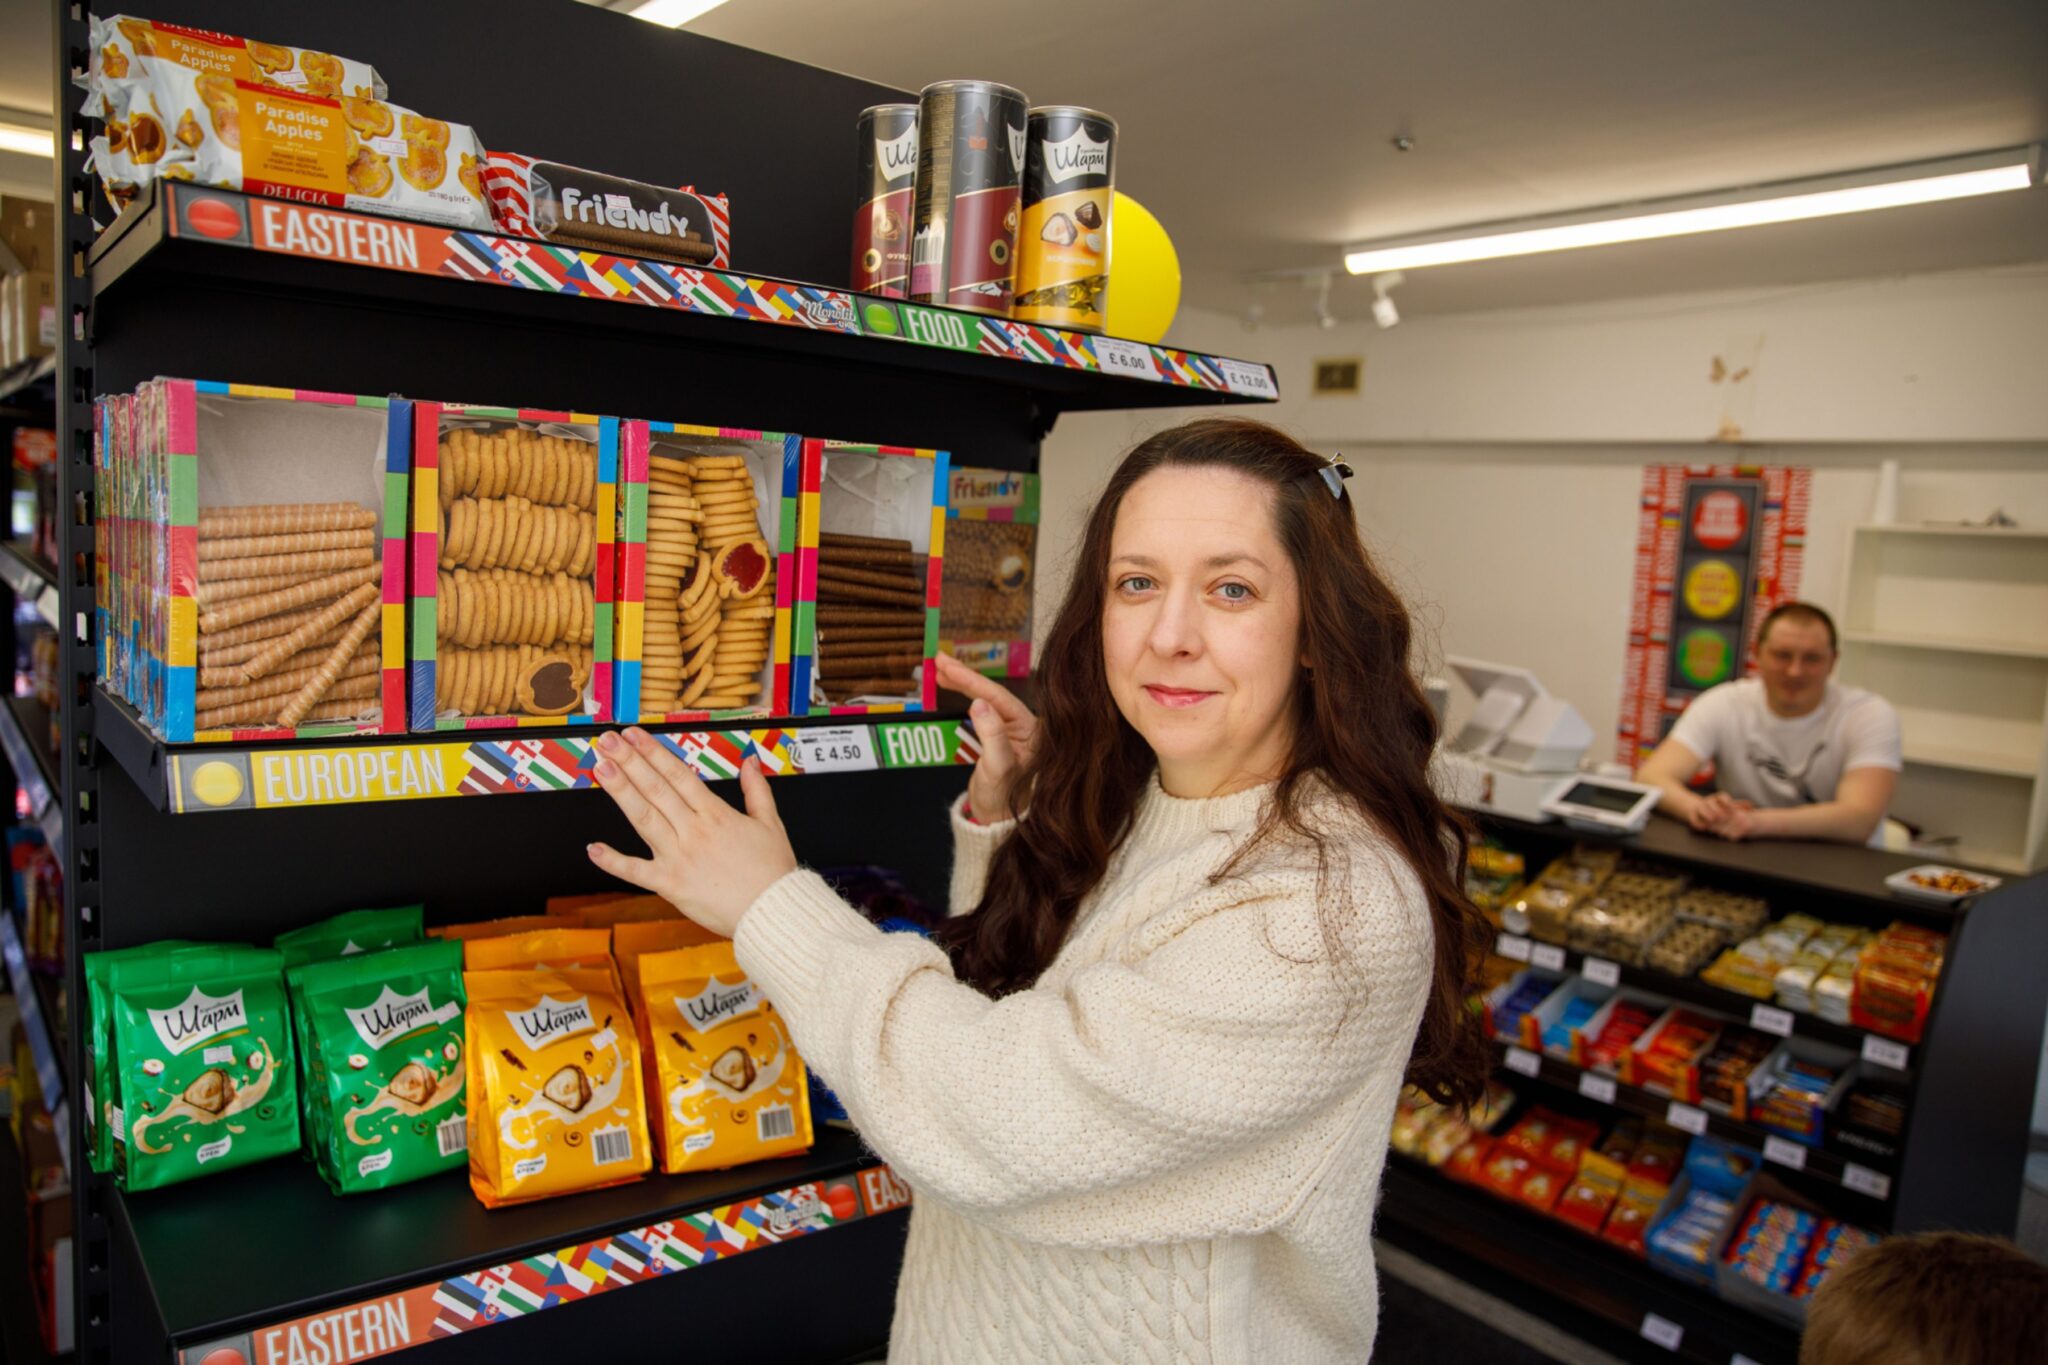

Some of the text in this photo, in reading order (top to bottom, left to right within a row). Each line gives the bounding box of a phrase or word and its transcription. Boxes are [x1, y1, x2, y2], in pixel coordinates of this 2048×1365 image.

[171, 40, 236, 62] Paradise
[181, 53, 231, 72] Apples
[256, 102, 329, 127] Paradise
[265, 119, 323, 141] Apples
[1055, 143, 1105, 171] Шарм
[262, 204, 419, 269] EASTERN
[905, 308, 968, 348] FOOD
[1109, 353, 1146, 370] £ 6.00
[1230, 372, 1268, 390] £ 12.00
[815, 747, 825, 762] £
[829, 744, 861, 761] 4.50
[885, 725, 947, 765] FOOD
[263, 749, 446, 804] EUROPEAN
[164, 1004, 240, 1040] Шарм
[361, 1003, 429, 1035] Шарм
[520, 1008, 587, 1037] Шарм
[864, 1169, 910, 1210] EAS
[265, 1297, 411, 1365] EASTERN
